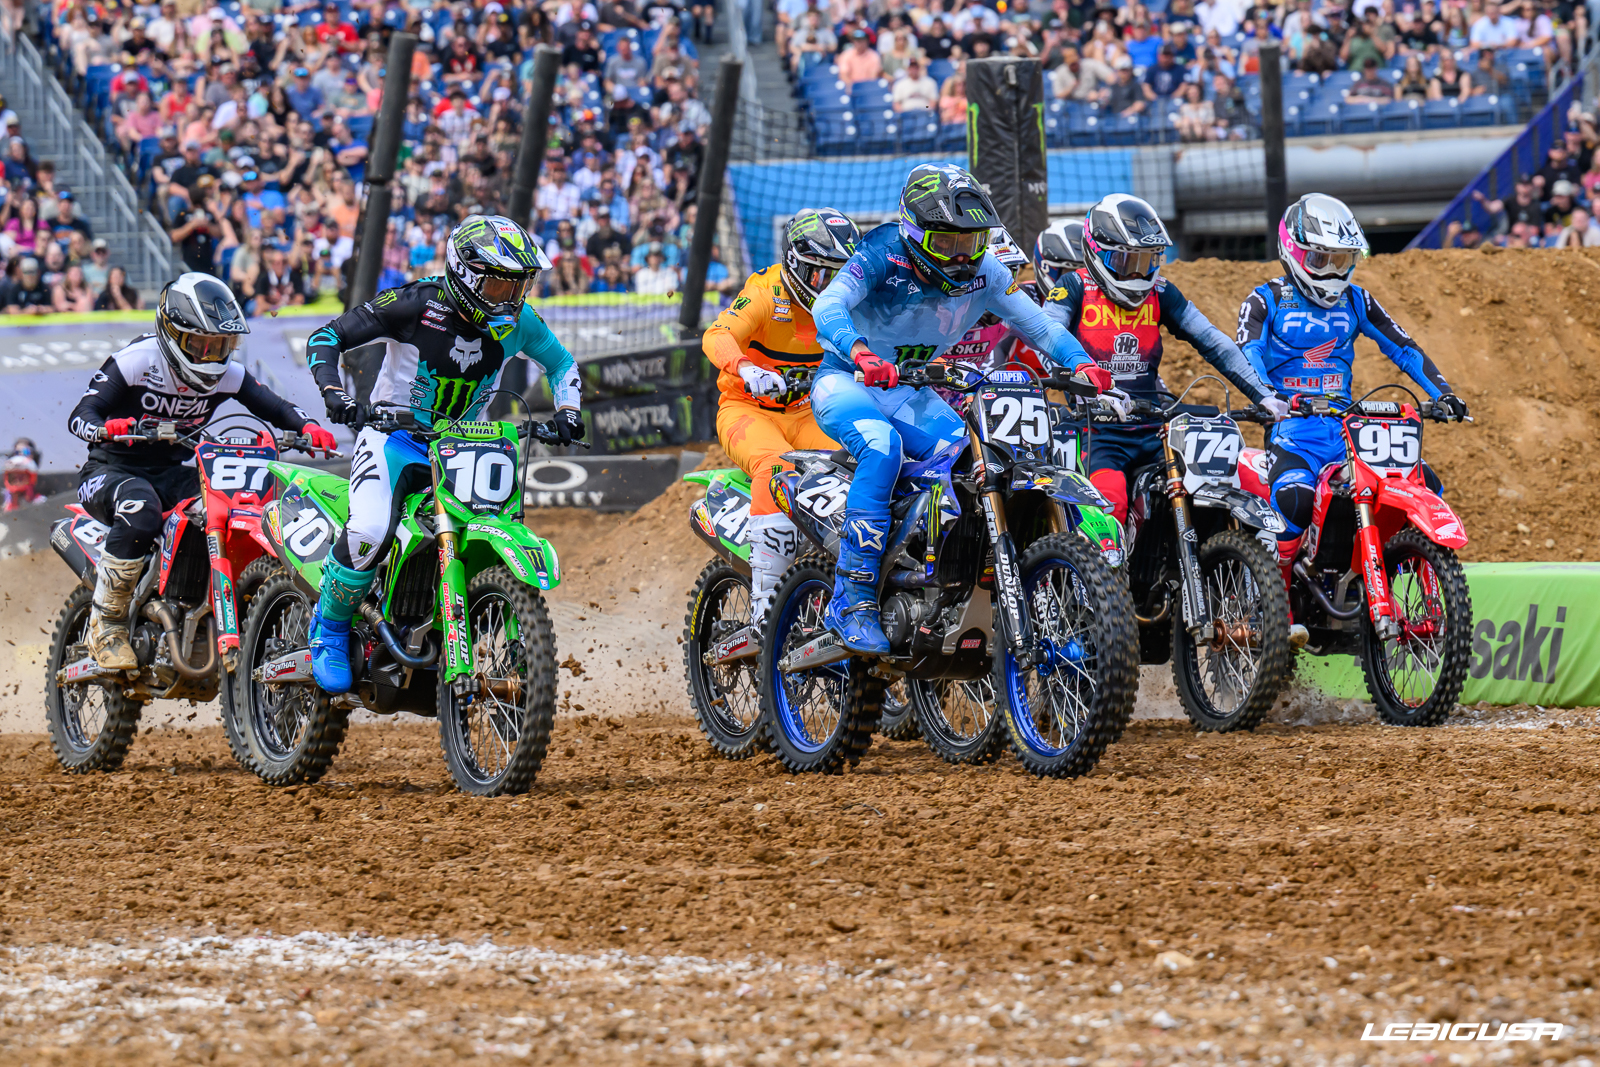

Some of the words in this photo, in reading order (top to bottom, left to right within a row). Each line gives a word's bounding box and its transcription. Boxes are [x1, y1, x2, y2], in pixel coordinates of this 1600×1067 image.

[1282, 312, 1350, 333] FXR
[1283, 377, 1320, 389] SLH
[990, 396, 1049, 444] 25
[1184, 431, 1240, 465] 174
[1358, 424, 1420, 464] 95
[210, 456, 272, 491] 87
[446, 450, 515, 503] 10
[282, 507, 330, 557] 10
[1000, 552, 1019, 620] DUNLOP
[223, 596, 236, 631] OTOREX
[455, 592, 470, 666] DNLOP
[1469, 604, 1567, 684] saki
